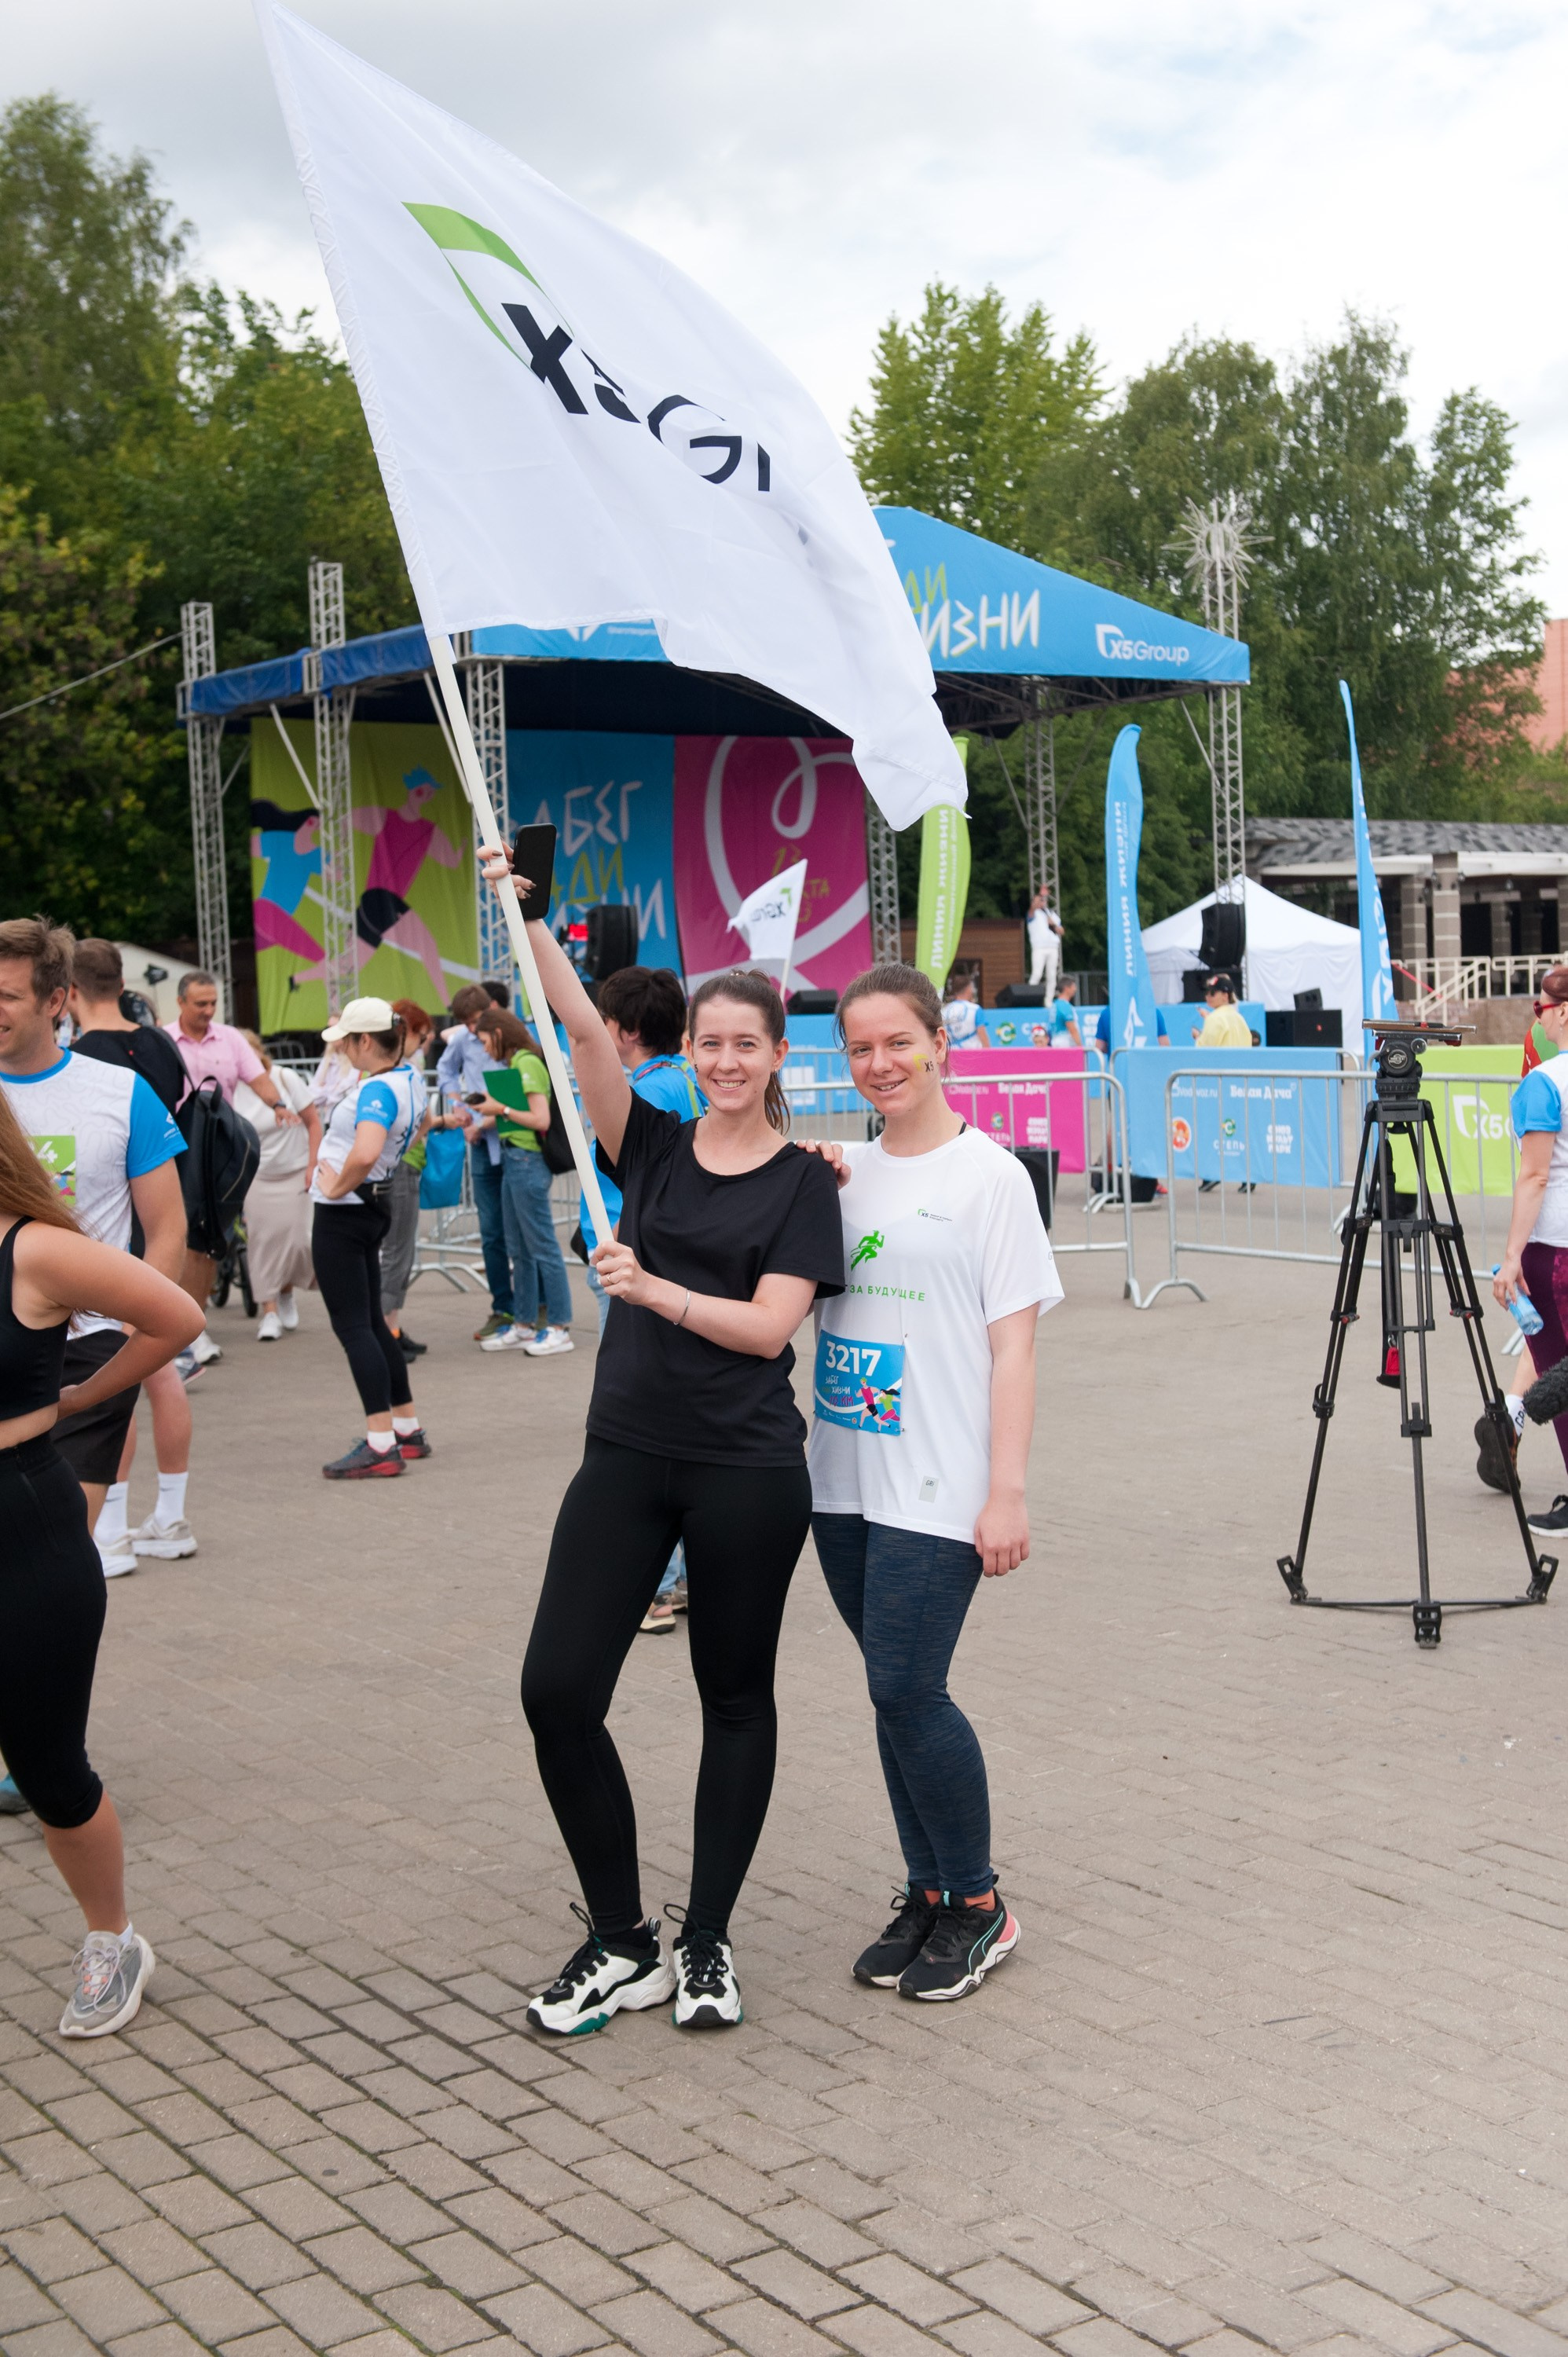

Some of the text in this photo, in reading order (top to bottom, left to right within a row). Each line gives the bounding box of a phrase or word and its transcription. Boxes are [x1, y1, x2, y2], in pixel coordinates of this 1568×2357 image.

[904, 561, 947, 614] ДИ
[919, 589, 1040, 659] ИЗНИ
[1109, 639, 1190, 666] X5Group
[550, 842, 624, 909] ДИ
[849, 1285, 925, 1301] ЗА БУДУЩЕЕ
[826, 1340, 881, 1376] 3217
